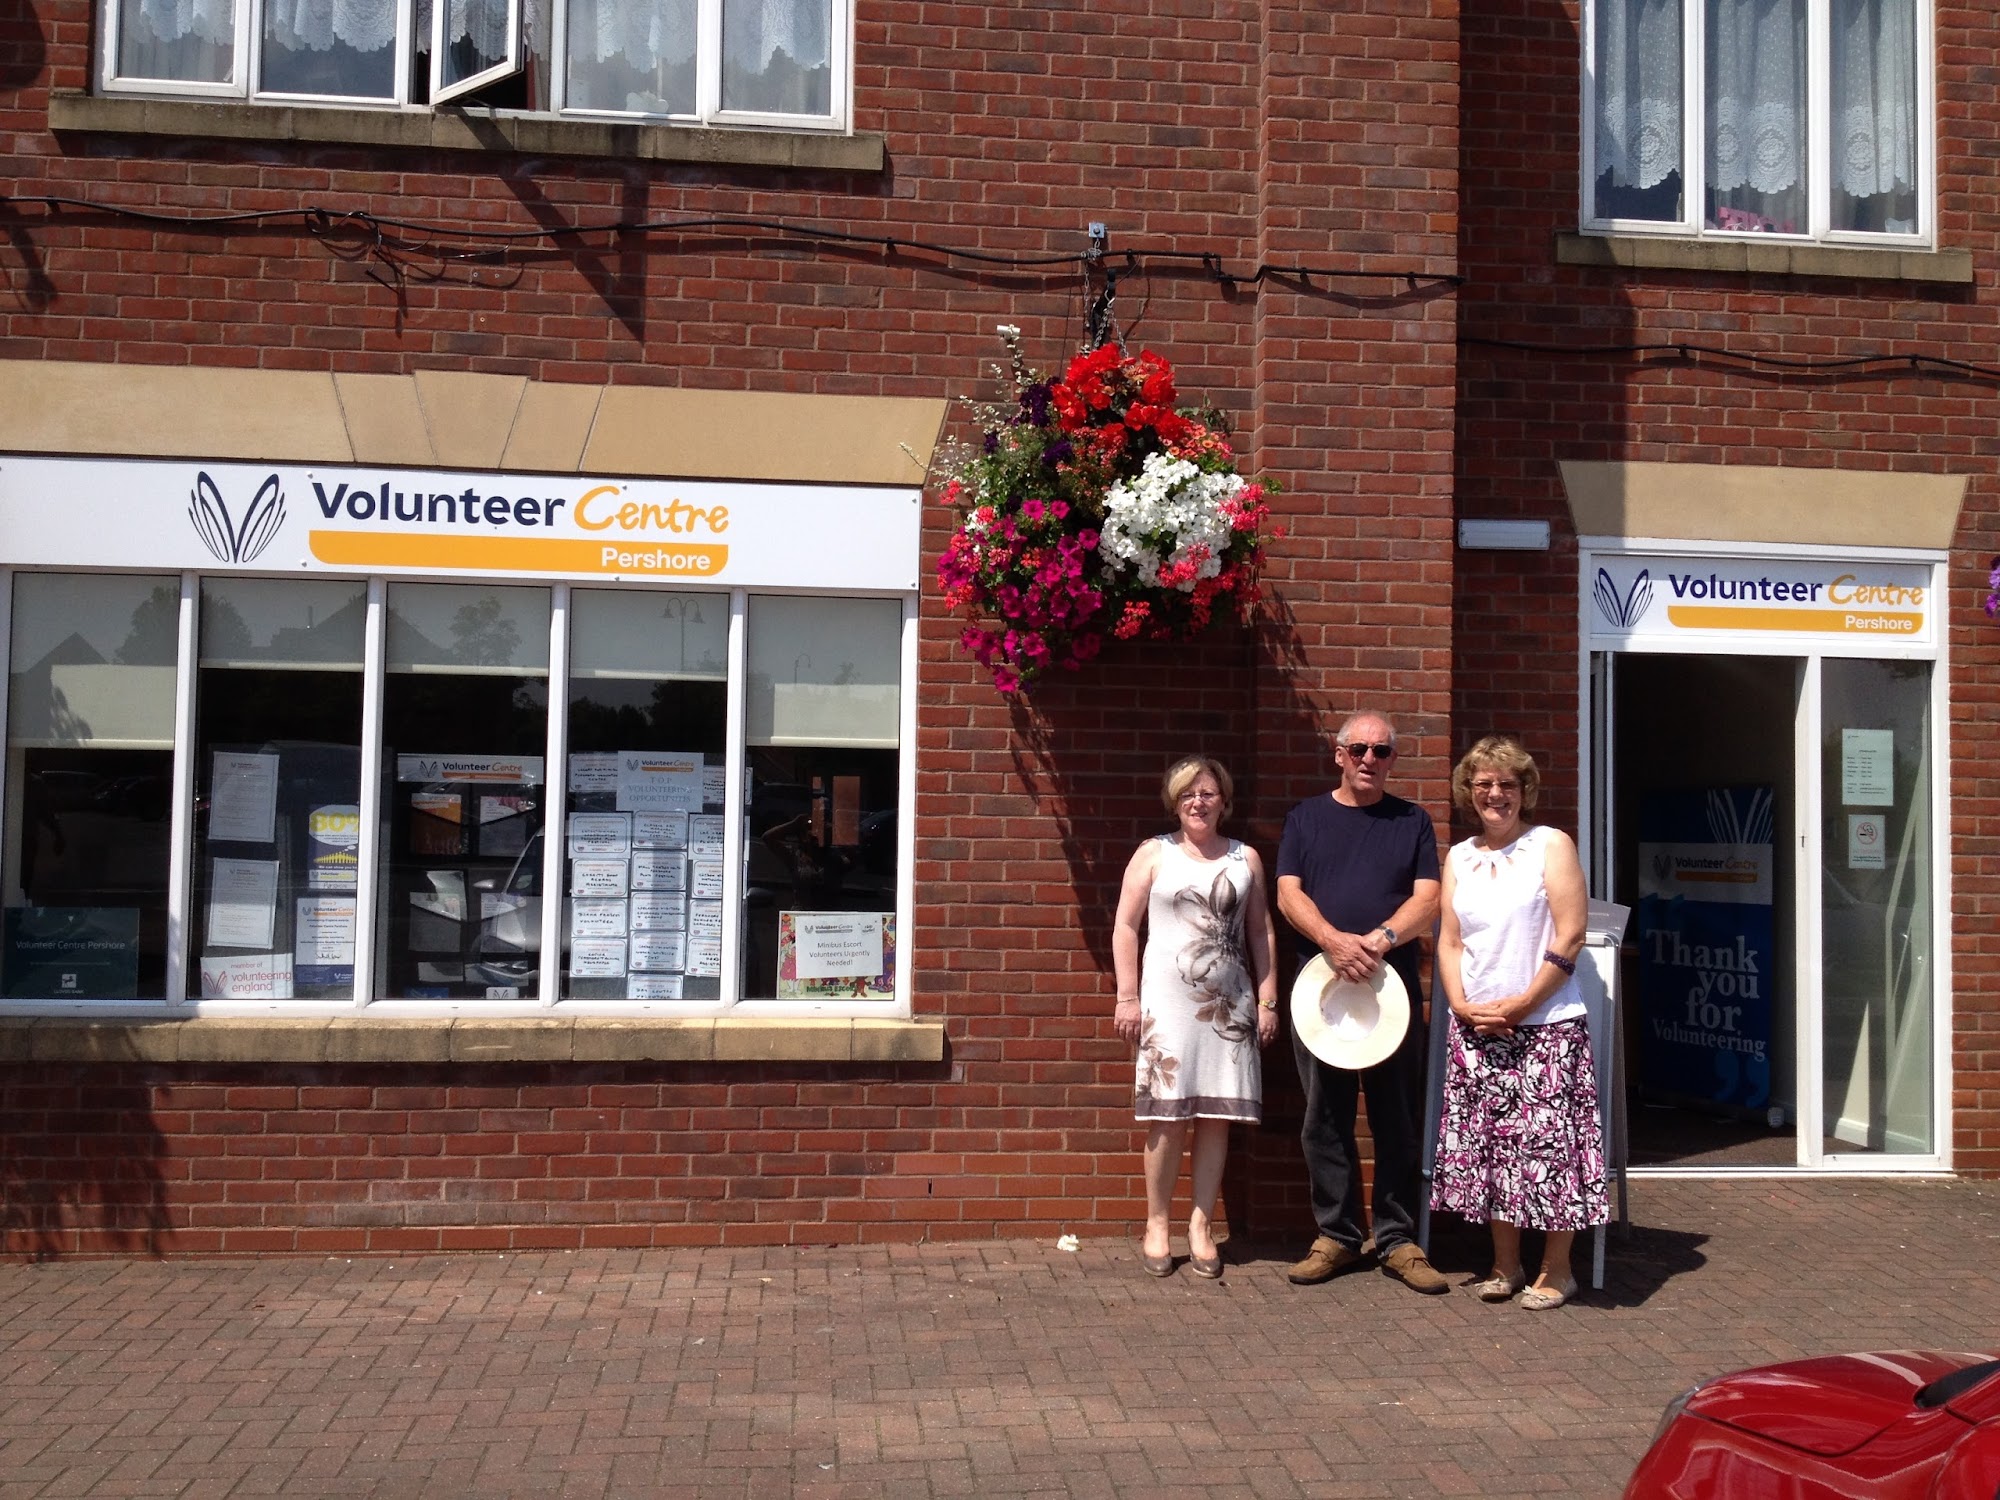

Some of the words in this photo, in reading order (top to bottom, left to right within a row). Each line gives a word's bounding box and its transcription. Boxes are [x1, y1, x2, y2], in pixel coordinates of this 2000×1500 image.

[312, 482, 566, 527] Volunteer
[573, 485, 729, 533] Centre
[601, 547, 711, 570] Pershore
[1668, 573, 1823, 602] Volunteer
[1828, 574, 1924, 606] Centre
[1845, 615, 1912, 630] Pershore
[442, 762, 490, 771] Volunteer
[491, 762, 523, 772] Centre
[628, 785, 693, 794] VOLUNTEERING
[1675, 857, 1724, 869] Volunteer
[16, 941, 56, 949] Volunteer
[57, 941, 85, 949] Centre
[87, 941, 125, 950] Pershore
[1645, 928, 1759, 973] Thank
[231, 971, 291, 981] volunteering
[231, 981, 273, 994] england
[1697, 970, 1760, 1005] you
[1685, 986, 1742, 1031] for
[1652, 1018, 1766, 1062] Volunteering
